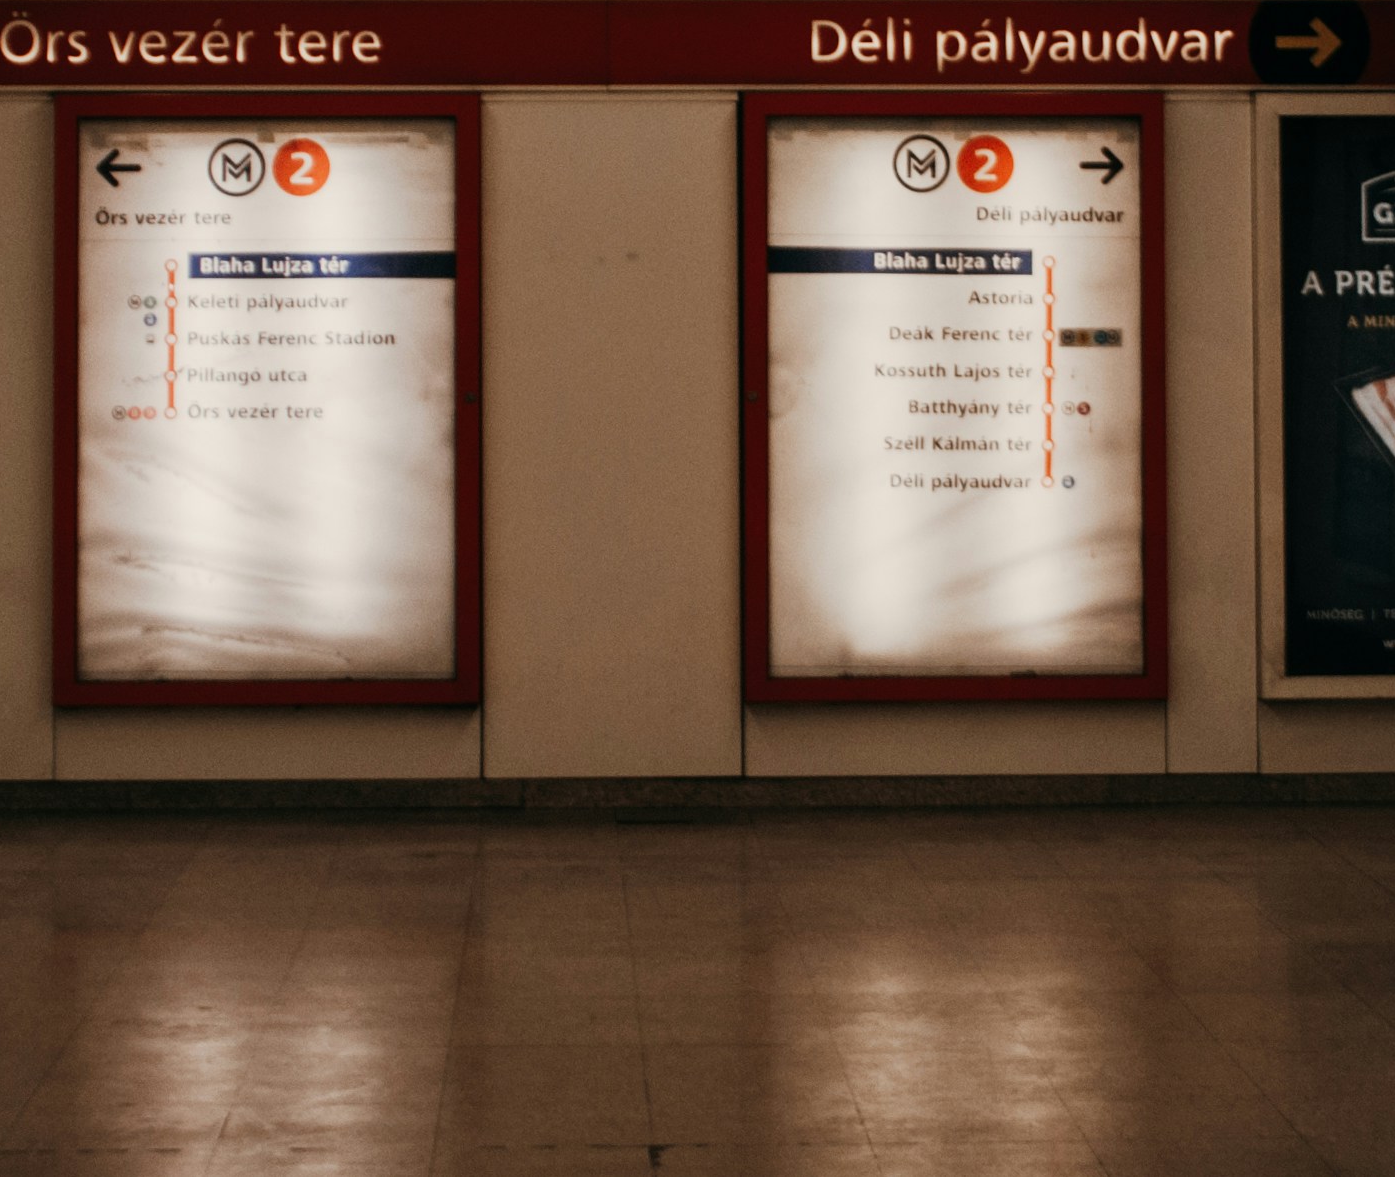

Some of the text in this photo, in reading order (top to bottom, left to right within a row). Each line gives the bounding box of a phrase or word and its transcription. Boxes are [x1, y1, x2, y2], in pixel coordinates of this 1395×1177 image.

[0, 11, 383, 64] Örs vezér tere
[809, 16, 1233, 74] Déli pályaudvar
[289, 152, 313, 186] 2
[973, 148, 998, 182] 2
[95, 205, 232, 225] Örs vezér tere
[976, 206, 1124, 225] Déli pályaudvar
[199, 255, 350, 277] Blaha Lujza tér
[873, 252, 1022, 273] Blaha Lujza tér
[1300, 270, 1324, 296] A
[187, 294, 348, 313] Keleti pályaudvar
[967, 290, 1034, 306] Astoria
[187, 331, 397, 346] Puskás Ferenc Stadion
[889, 326, 1033, 341] Deák Ferenc tér
[187, 368, 309, 386] Pillangó utca
[874, 363, 1033, 382] Kossuth Lajos tér
[187, 402, 324, 420] Örs vezér tere
[908, 400, 1032, 418] Batthyány tér
[883, 435, 1032, 452] Széll Kálmán tér
[890, 473, 1032, 493] Déli pályaudvar
